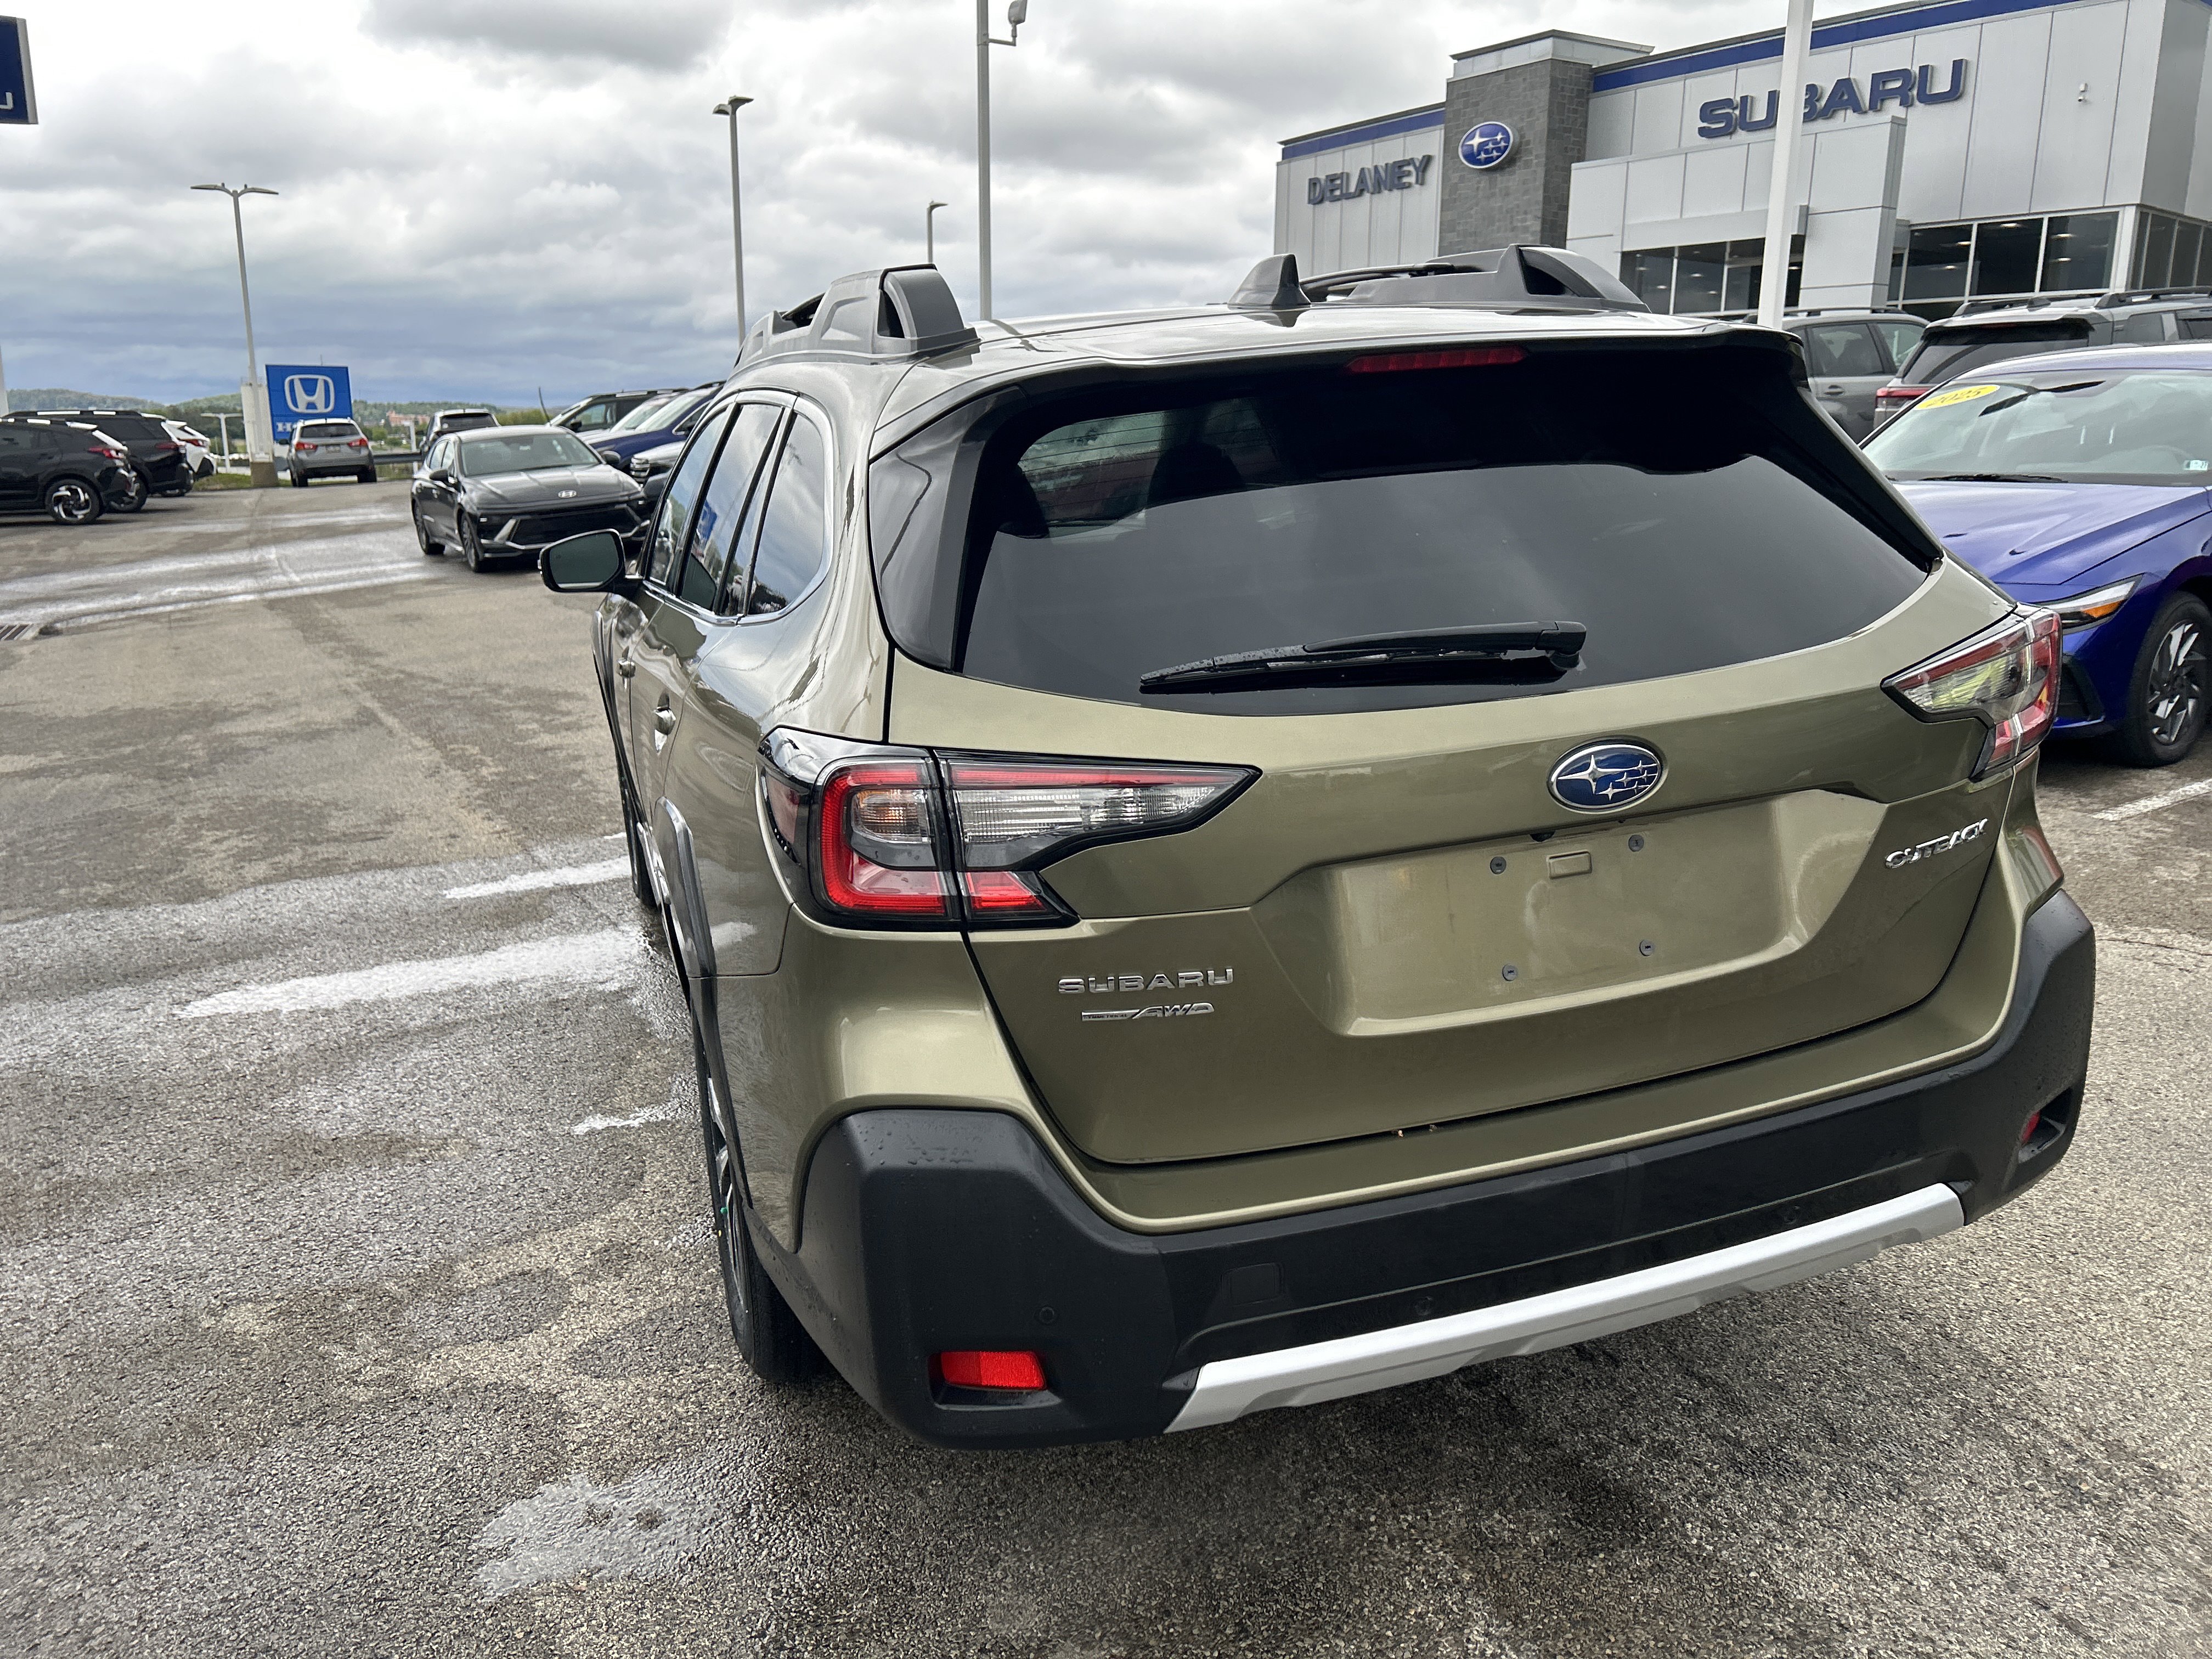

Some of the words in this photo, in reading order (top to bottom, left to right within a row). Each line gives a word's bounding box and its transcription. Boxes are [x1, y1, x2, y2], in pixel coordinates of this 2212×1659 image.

[1308, 155, 1432, 205] DELANEY
[1058, 969, 1233, 994] SUBARU
[1132, 1002, 1215, 1019] AWD
